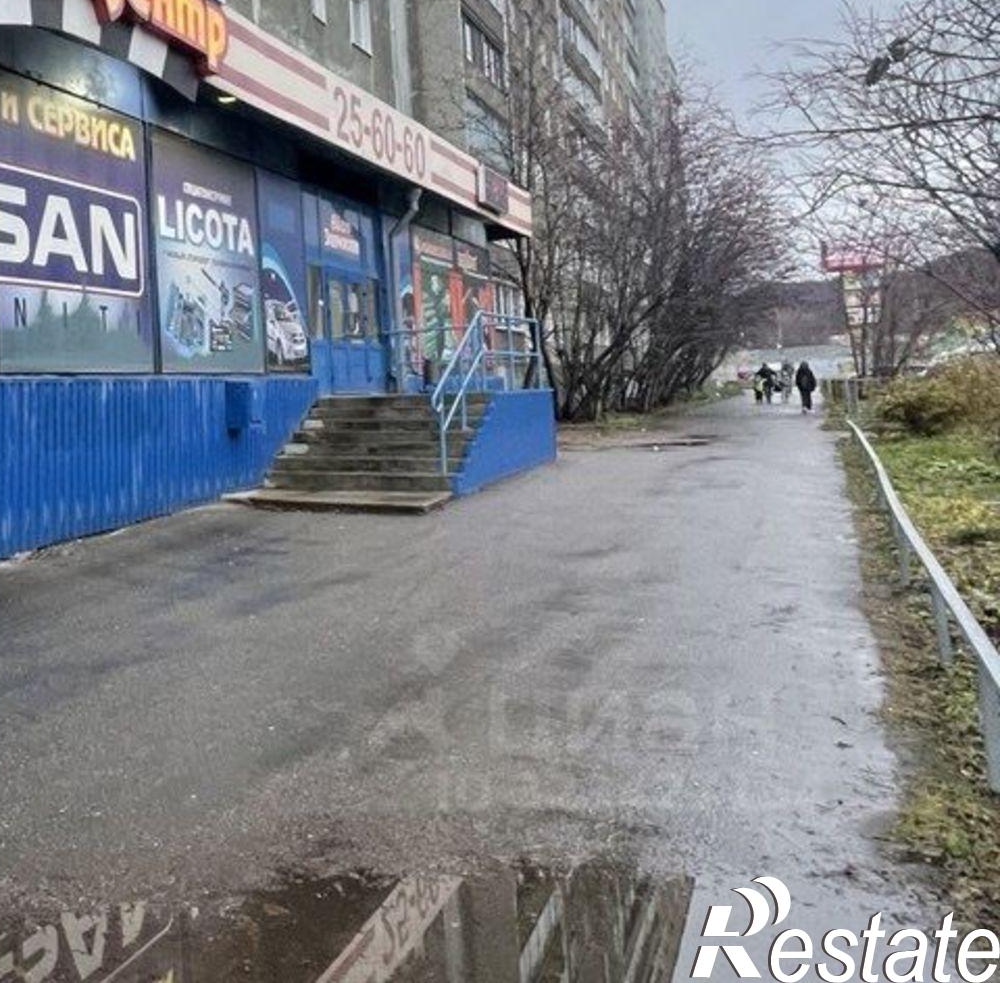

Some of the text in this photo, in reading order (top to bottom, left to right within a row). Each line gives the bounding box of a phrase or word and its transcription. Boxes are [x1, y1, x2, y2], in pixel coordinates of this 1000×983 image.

[26, 98, 137, 161] СЕРВИСА
[333, 85, 426, 179] 25-60-60
[157, 195, 254, 255] LICOTA
